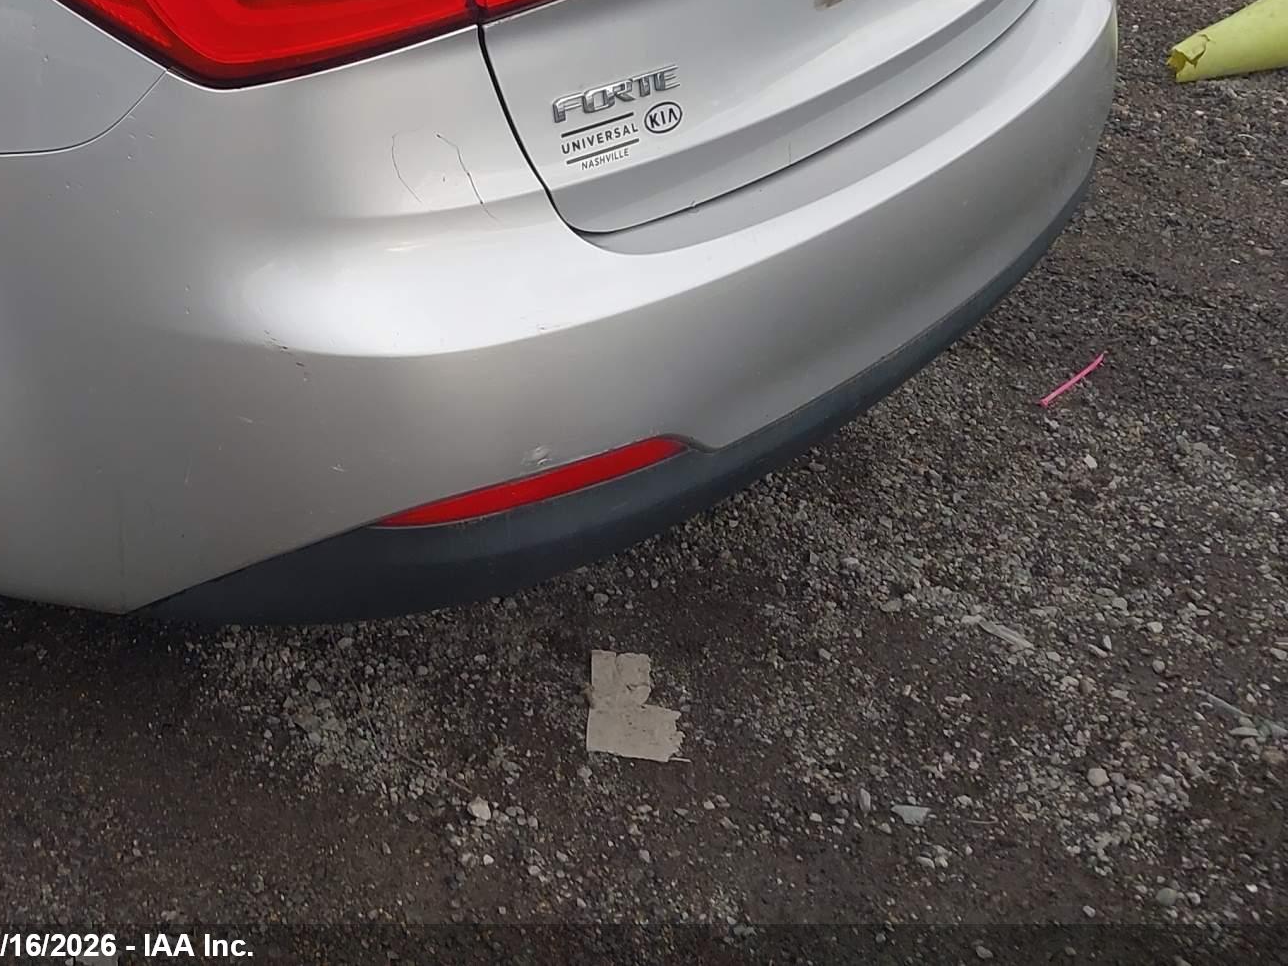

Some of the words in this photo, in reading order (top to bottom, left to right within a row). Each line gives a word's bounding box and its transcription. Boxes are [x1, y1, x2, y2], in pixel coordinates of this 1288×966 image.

[552, 64, 680, 123] FORTE
[561, 122, 639, 155] UNIVERSAL
[648, 107, 679, 129] KIA
[581, 148, 630, 171] NASHVILLE
